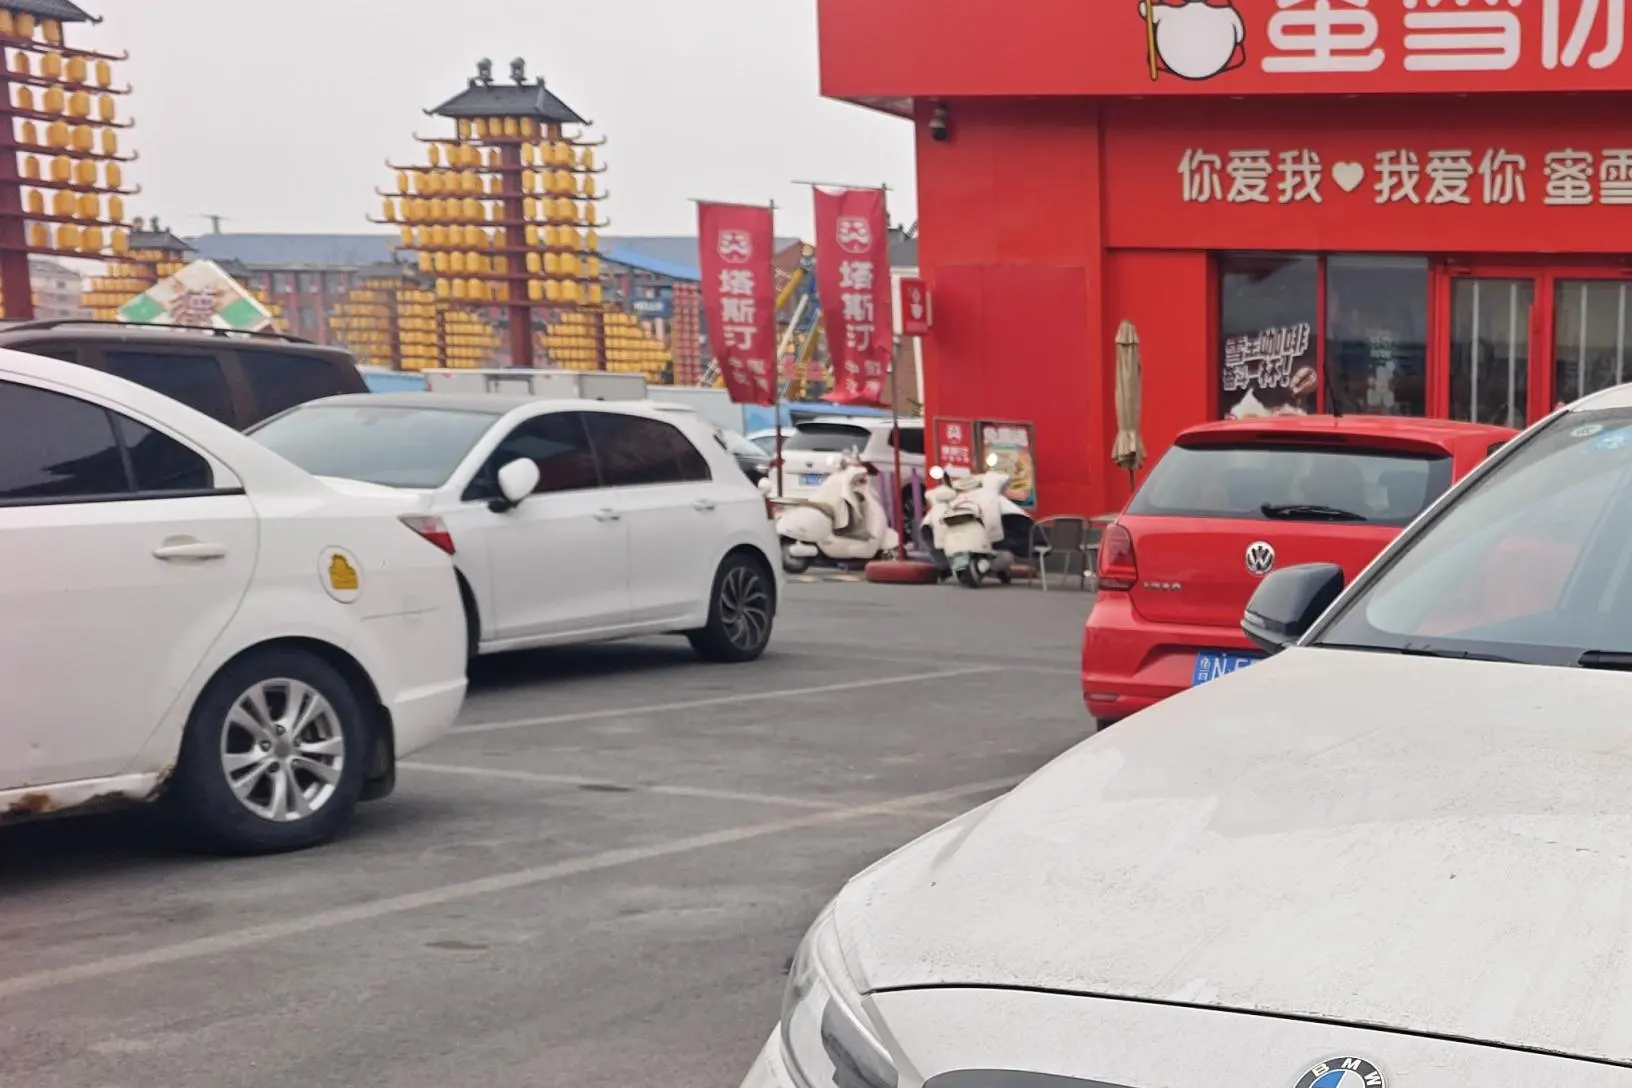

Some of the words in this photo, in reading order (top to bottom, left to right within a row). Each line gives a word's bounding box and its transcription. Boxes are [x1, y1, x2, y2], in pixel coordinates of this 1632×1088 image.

[718, 269, 757, 350] 塔斯汀
[838, 260, 875, 351] 塔斯汀
[1312, 1058, 1382, 1086] BMW
